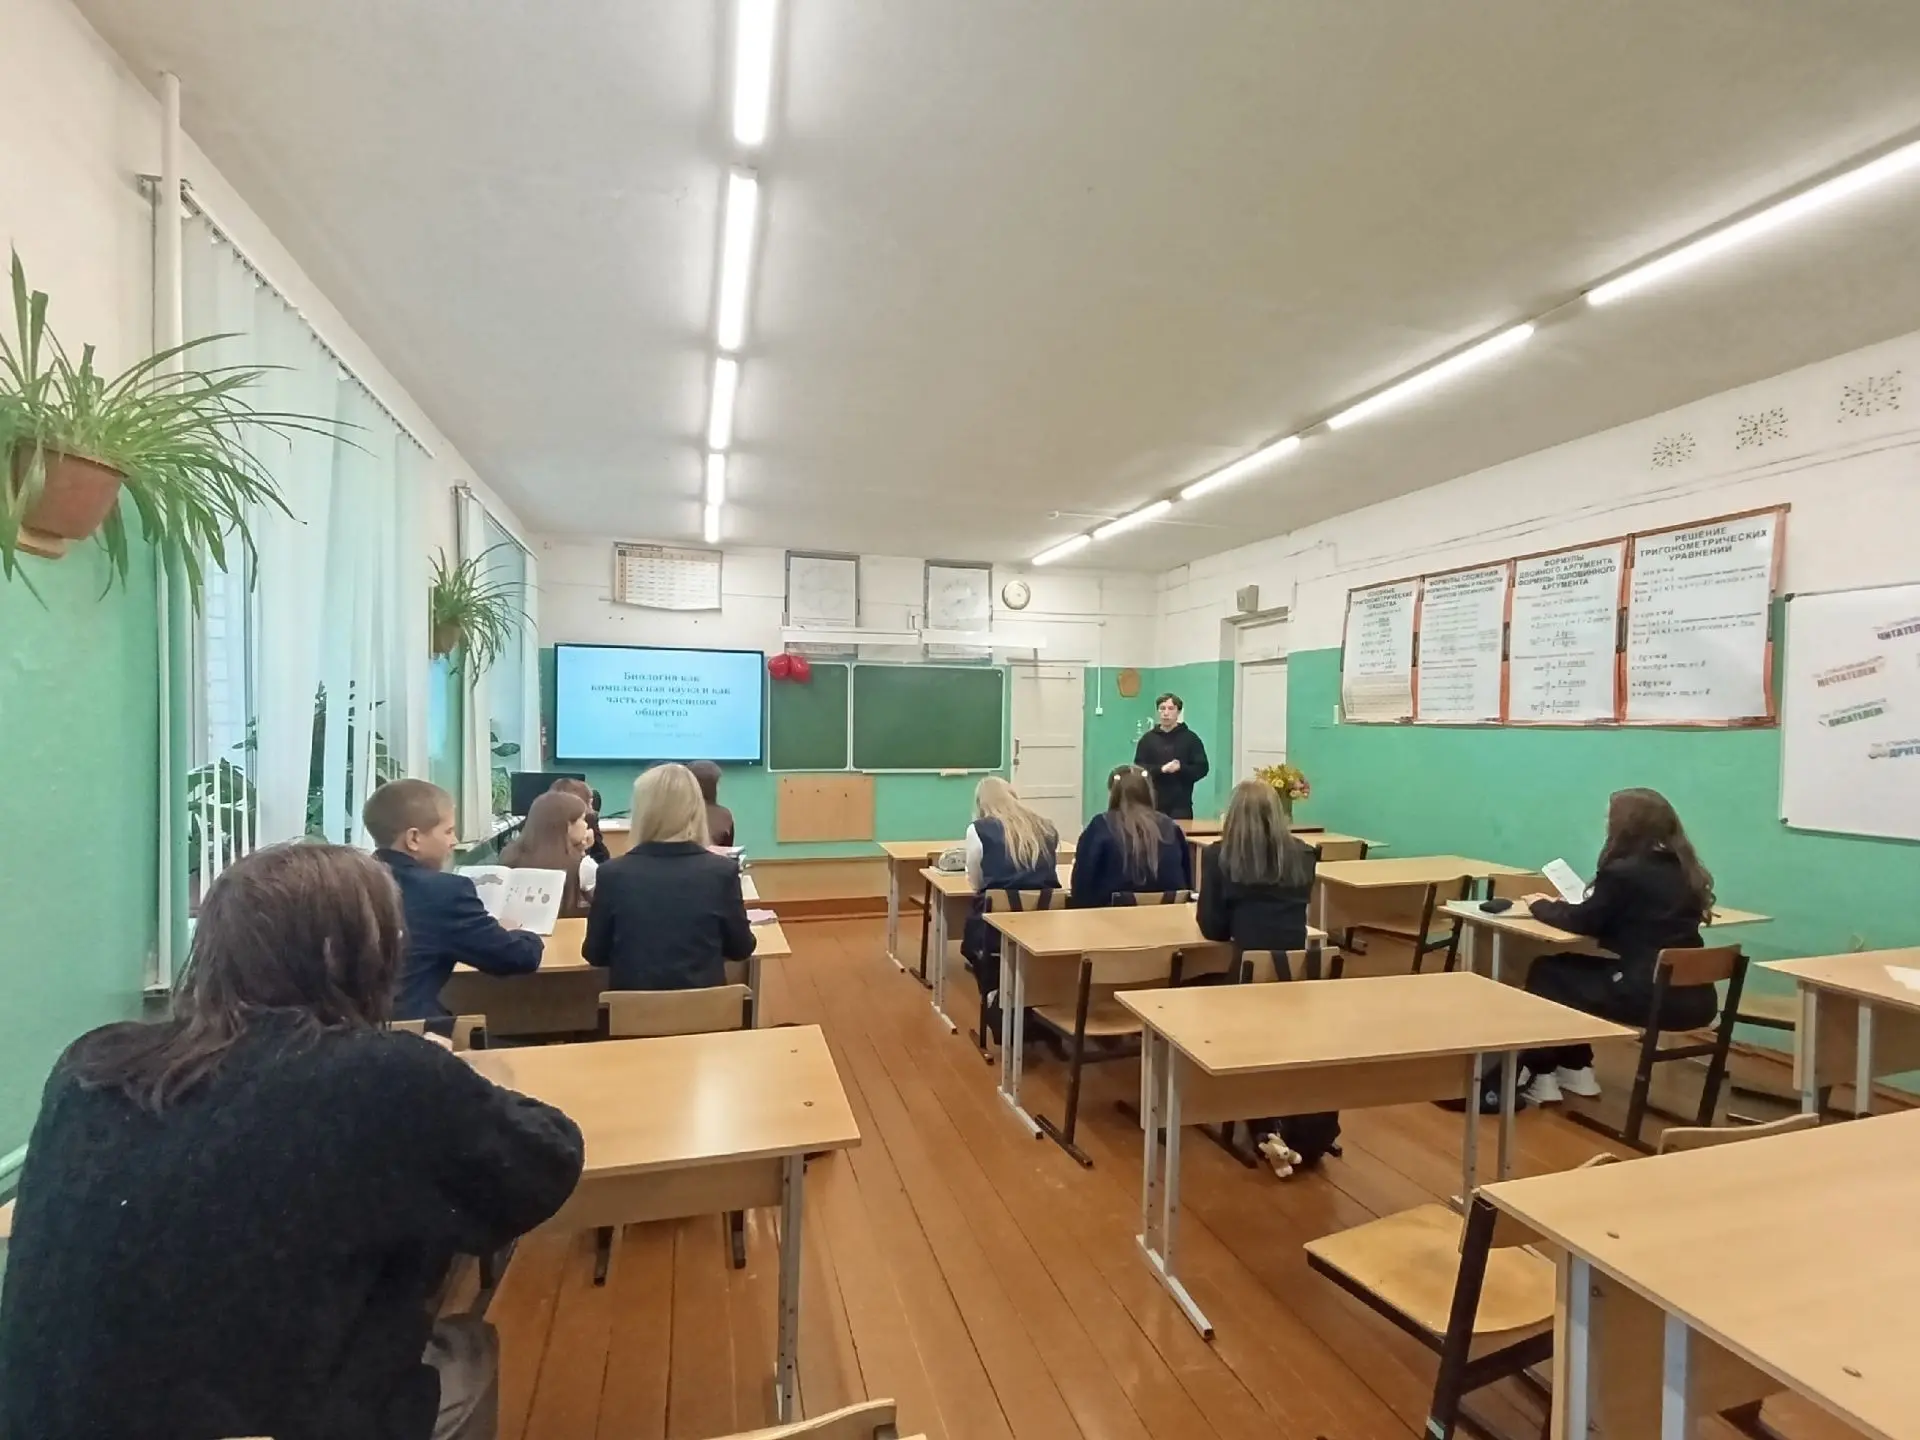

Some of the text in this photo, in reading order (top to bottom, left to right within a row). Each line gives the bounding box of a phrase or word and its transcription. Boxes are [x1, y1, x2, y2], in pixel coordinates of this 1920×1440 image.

[1675, 526, 1728, 542] РЕШЕНИЕ
[1640, 529, 1768, 557] ТРИГОНОМЕТРИЧЕСКИХ
[1544, 554, 1585, 567] ФОРМУЛЫ
[1563, 557, 1613, 572] АРГУМЕНТА
[1556, 565, 1617, 580] ПОЛОВИННОГО
[1541, 578, 1589, 590] АРГУМЕНТА
[623, 671, 701, 682] Биология как
[590, 684, 666, 694] комплексная
[605, 696, 637, 705] часть
